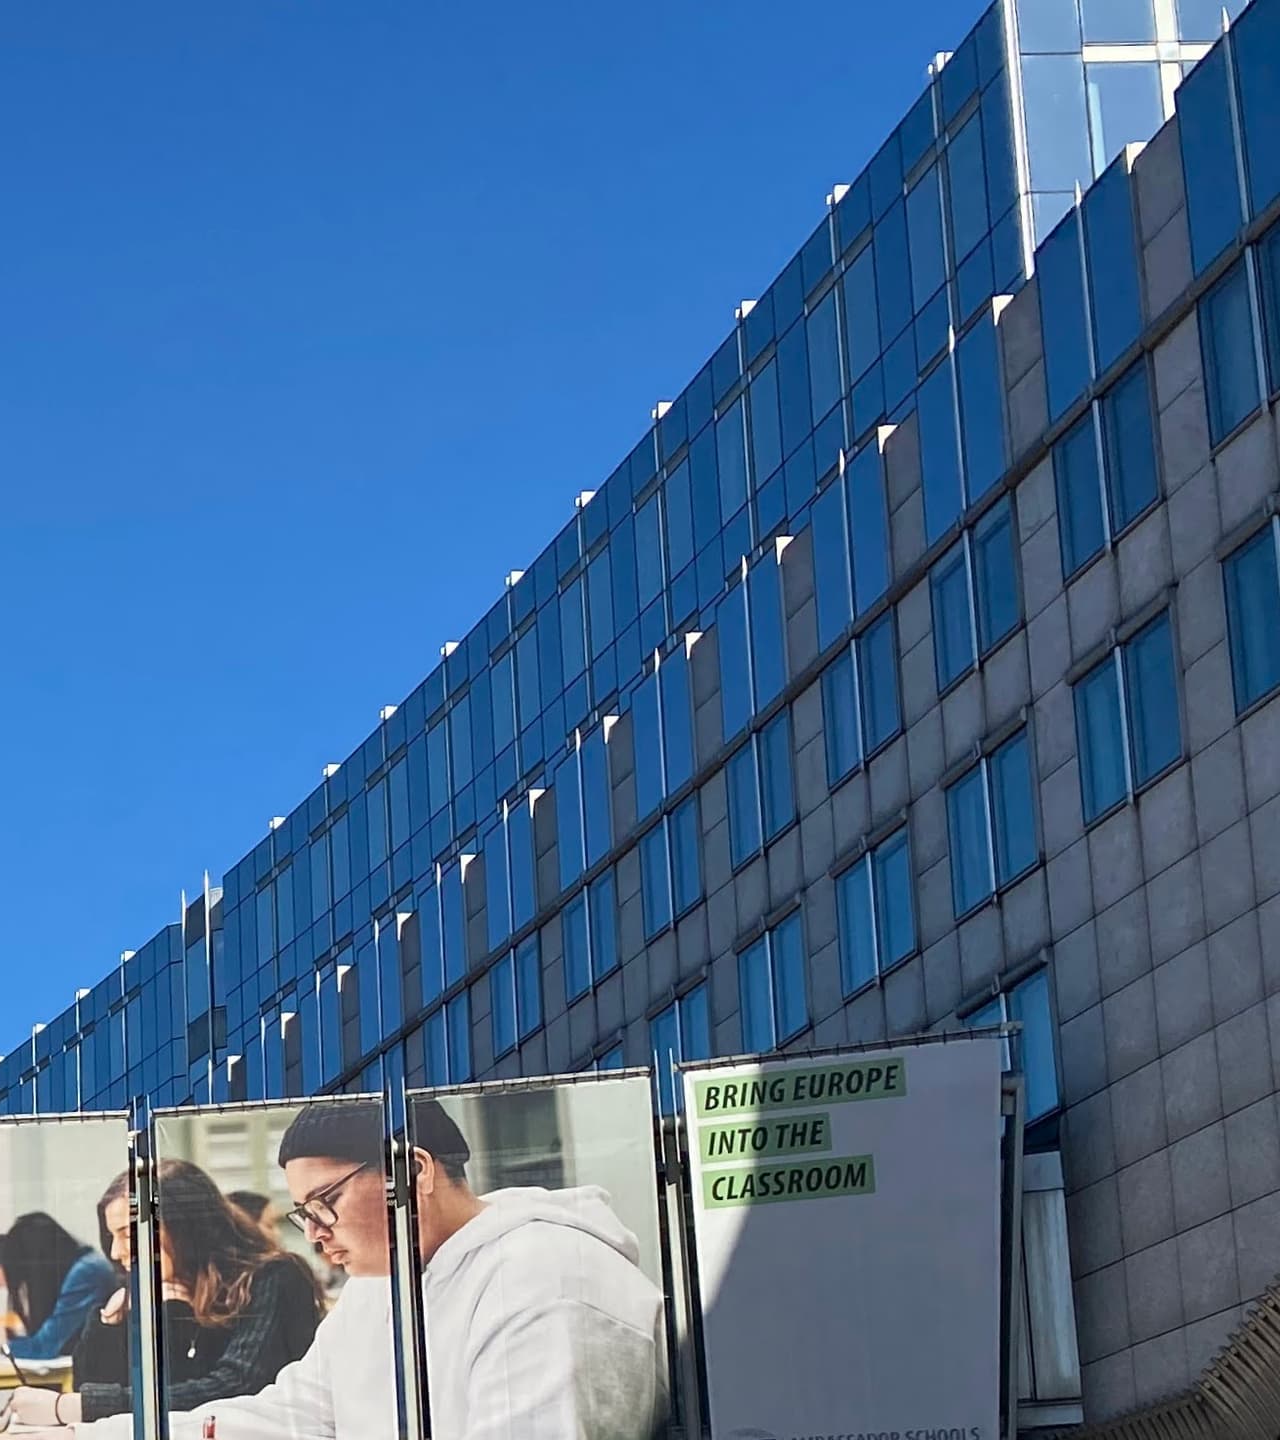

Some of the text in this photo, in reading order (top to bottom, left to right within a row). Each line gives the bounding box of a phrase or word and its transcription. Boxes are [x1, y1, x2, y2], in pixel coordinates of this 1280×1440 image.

[704, 1065, 899, 1110] BRING EUROPE
[708, 1120, 824, 1155] INTO THE
[712, 1162, 866, 1200] CLASSROOM
